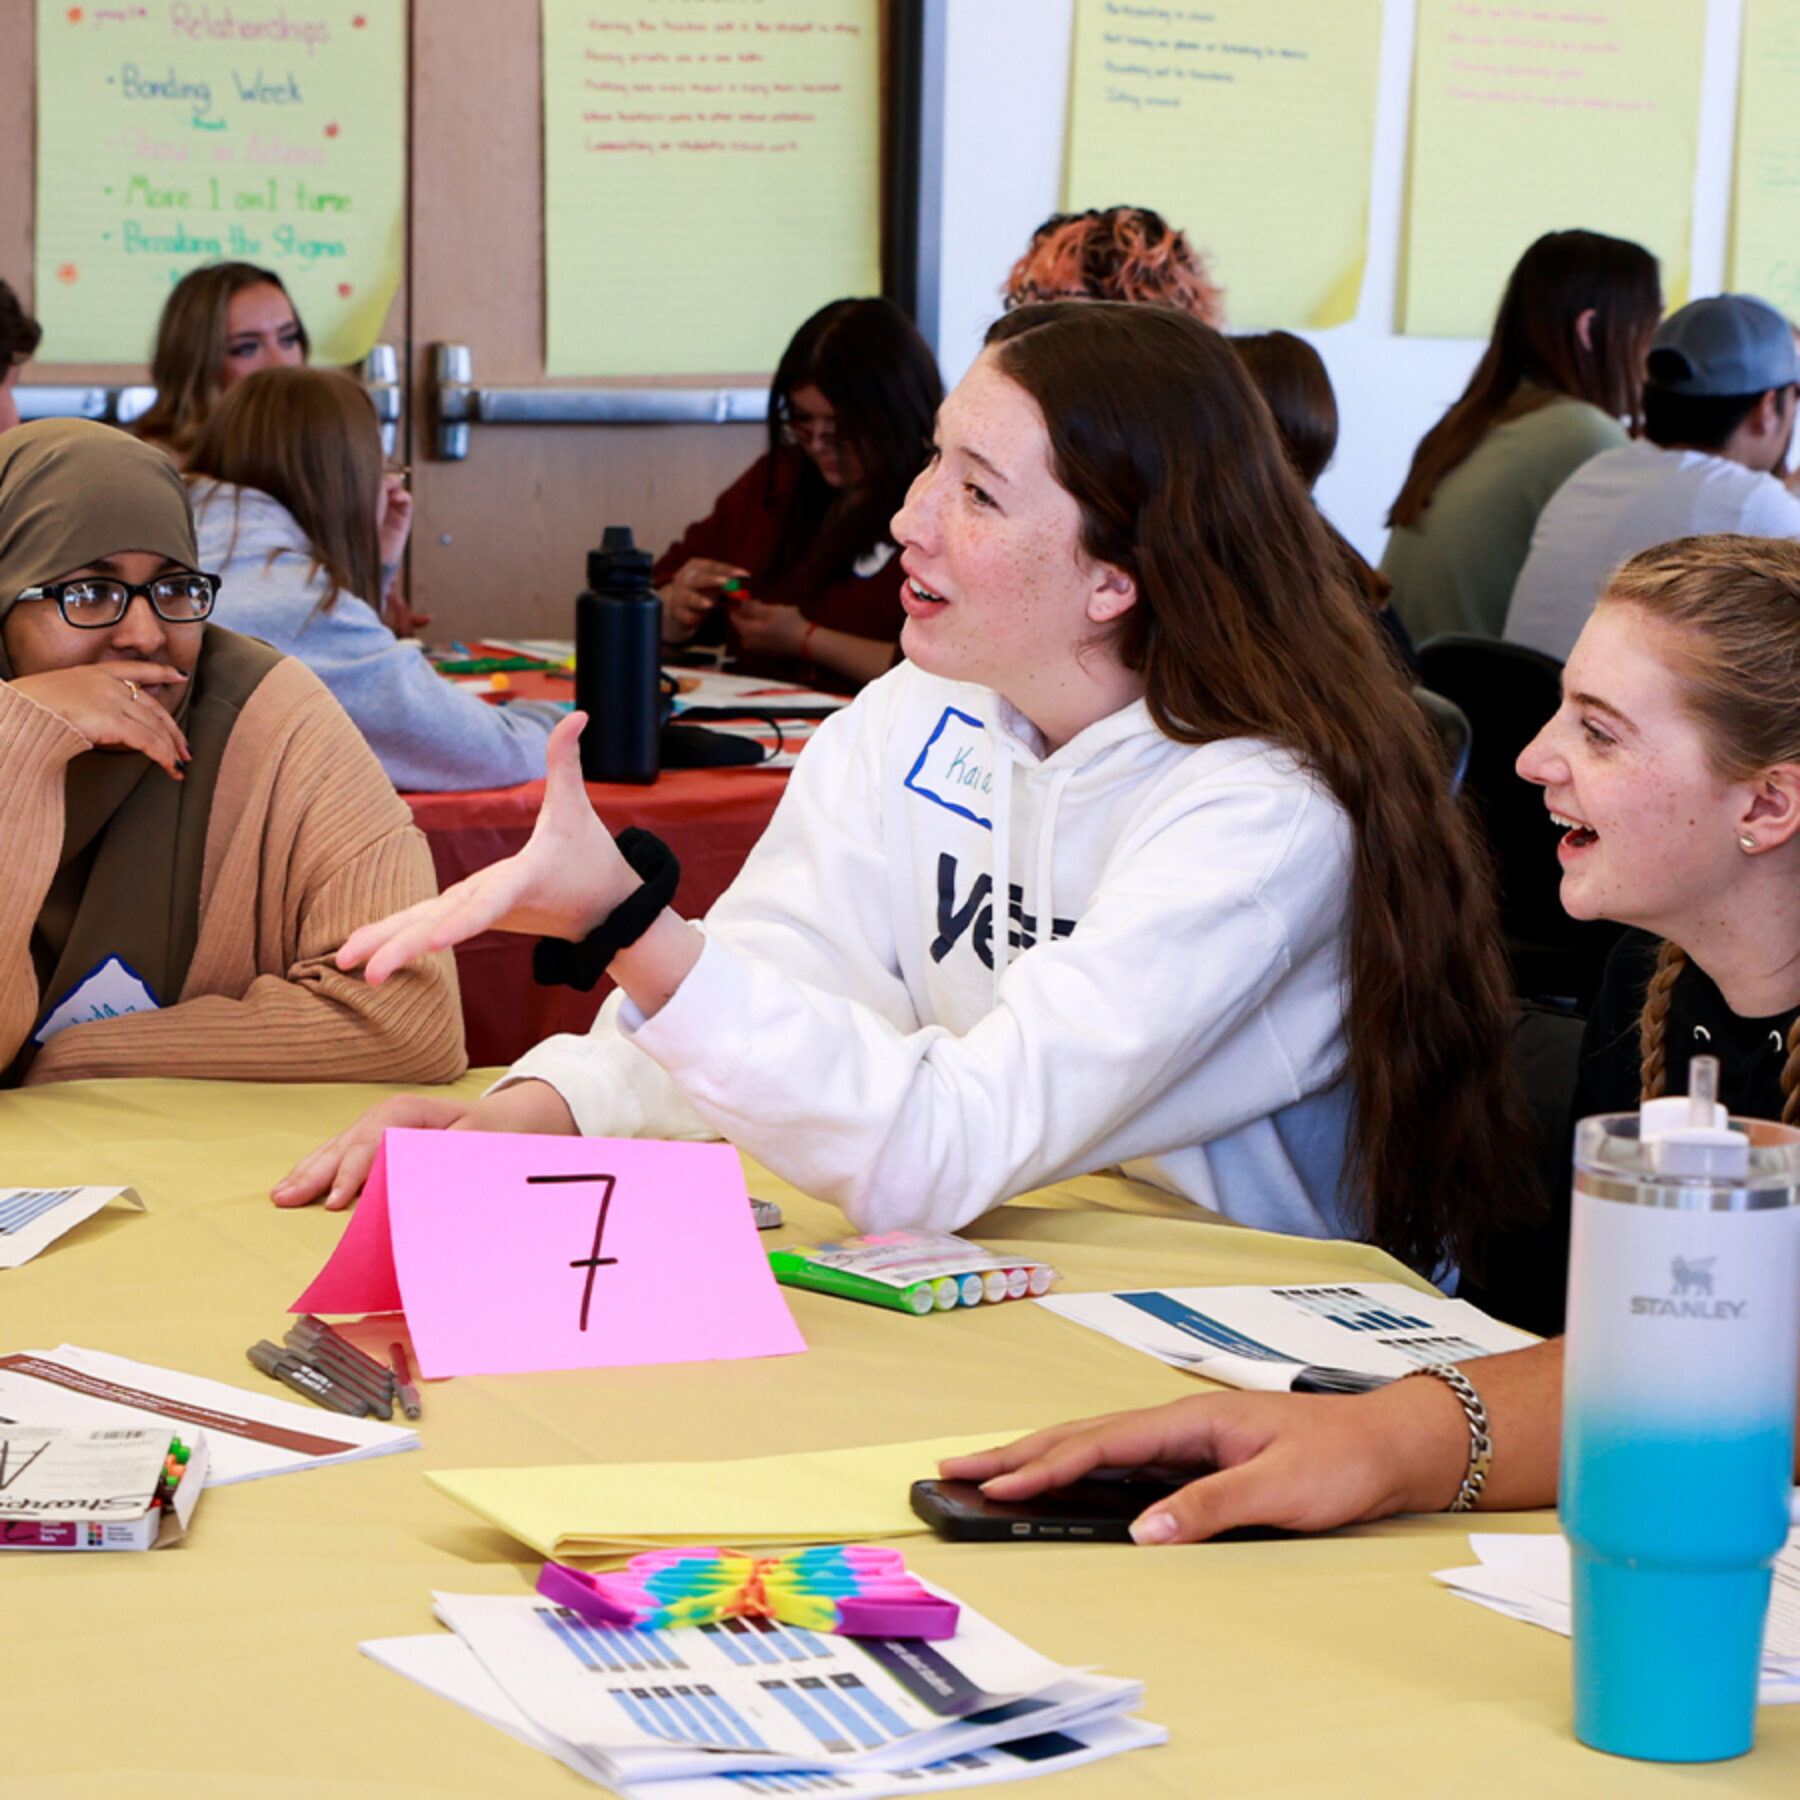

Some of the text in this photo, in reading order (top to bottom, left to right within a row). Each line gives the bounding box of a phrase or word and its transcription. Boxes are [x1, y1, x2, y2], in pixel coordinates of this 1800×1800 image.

[121, 62, 303, 115] Bonding Week
[125, 175, 191, 210] More
[295, 180, 352, 213] time
[122, 219, 222, 258] Breaking
[228, 224, 261, 255] the
[526, 1174, 618, 1332] 7
[1630, 1295, 1748, 1319] STANLEY
[0, 1493, 147, 1511] Sharp
